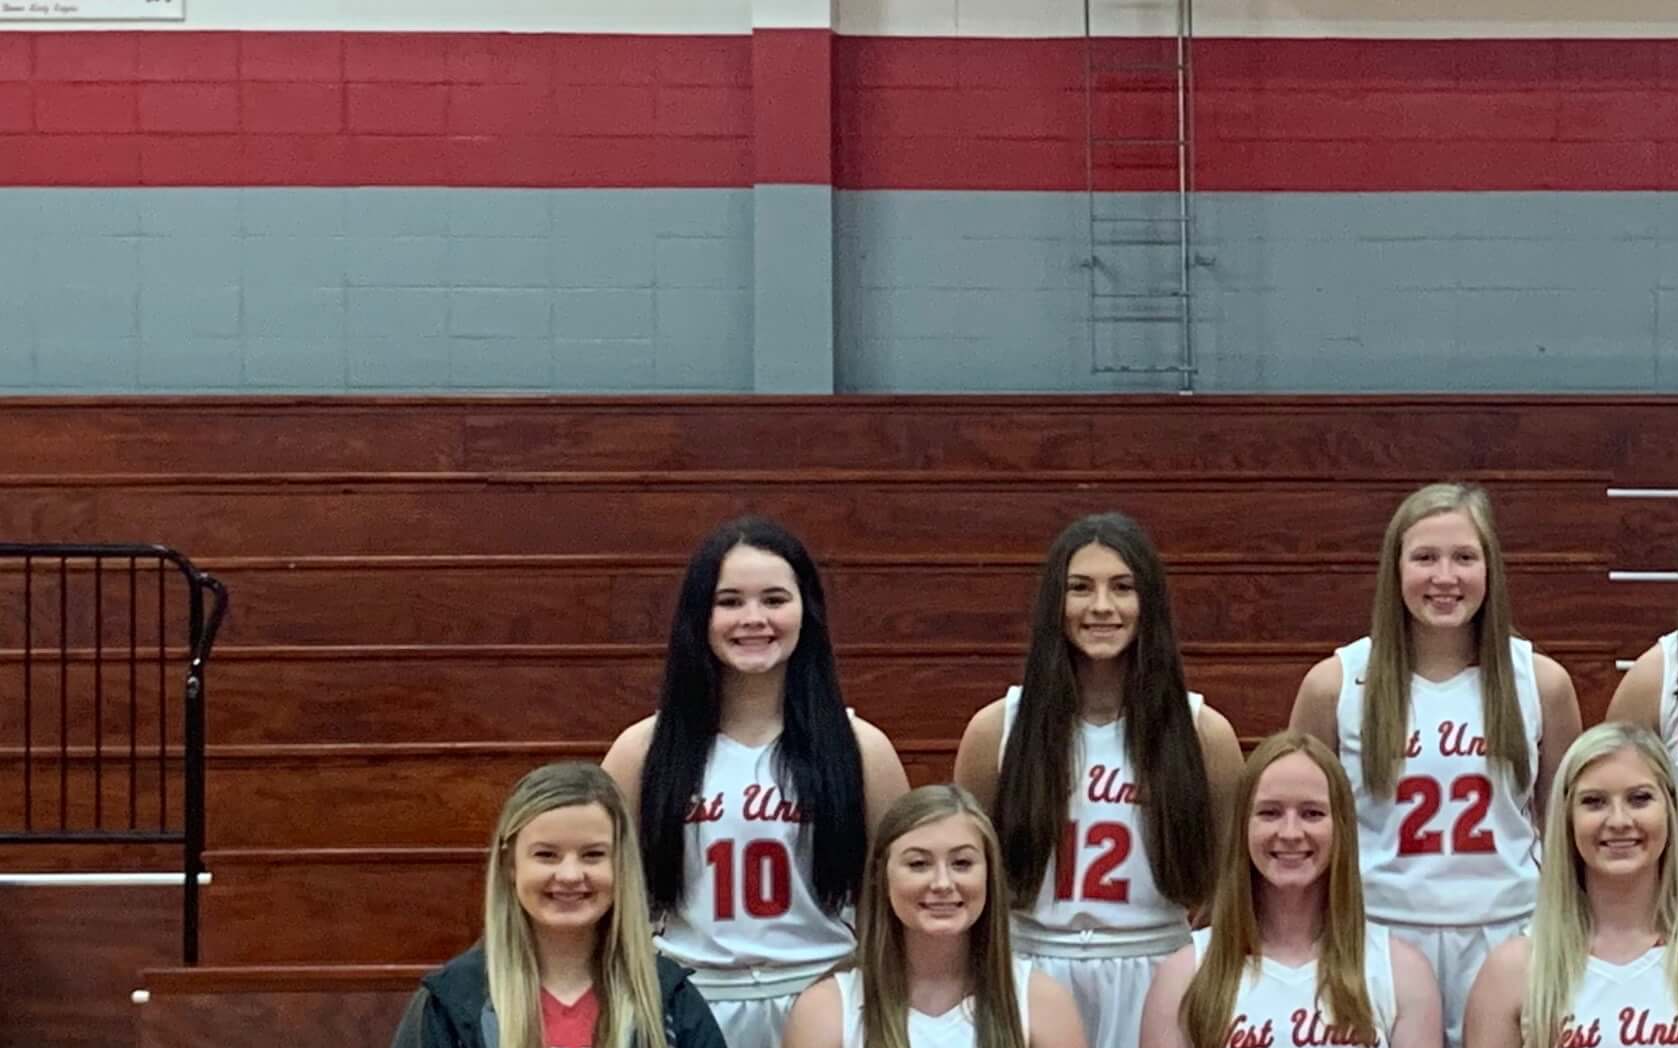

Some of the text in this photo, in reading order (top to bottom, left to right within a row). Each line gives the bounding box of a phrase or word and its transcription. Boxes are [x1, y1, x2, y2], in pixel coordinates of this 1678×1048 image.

[1396, 773, 1497, 857] 22
[705, 838, 792, 921] 10
[1055, 819, 1132, 903] 12
